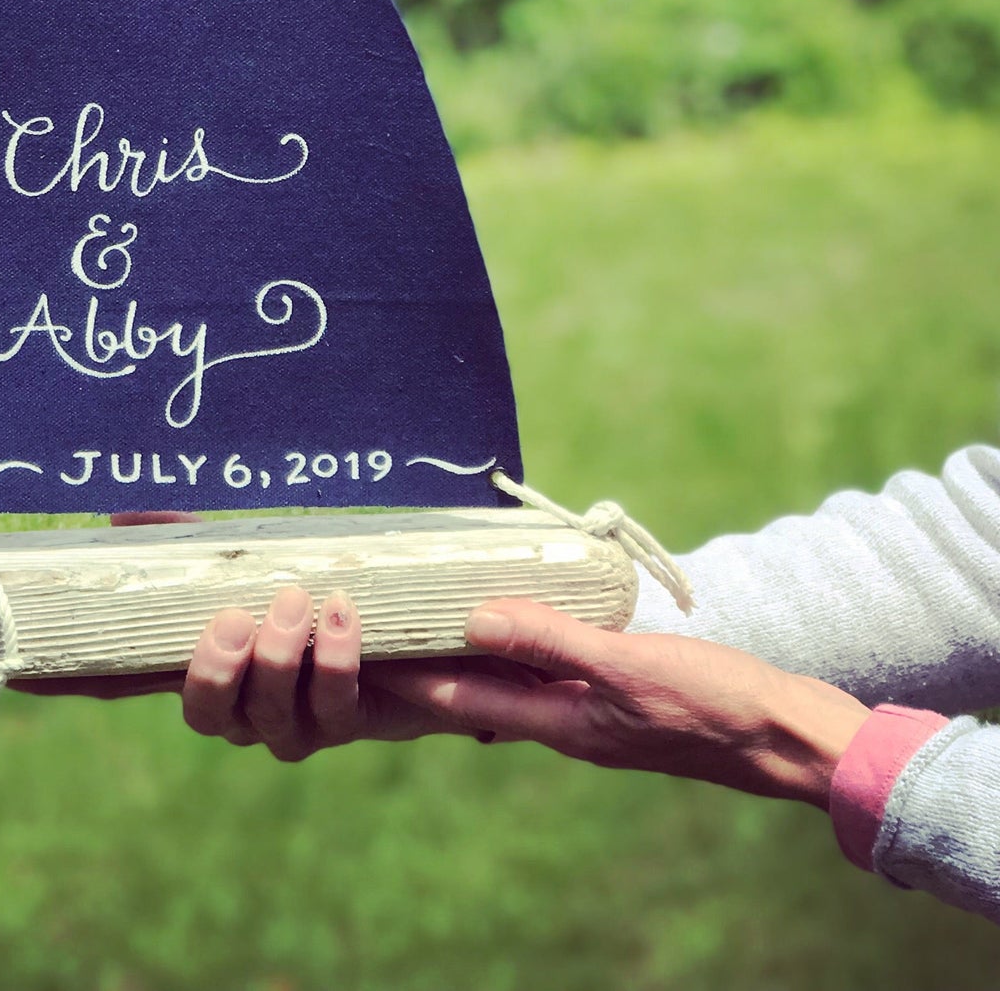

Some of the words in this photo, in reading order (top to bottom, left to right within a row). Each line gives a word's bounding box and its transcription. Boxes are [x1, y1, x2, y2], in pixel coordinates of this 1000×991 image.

[1, 102, 309, 198] Chris
[70, 213, 139, 290] &
[60, 450, 208, 487] JULY
[222, 453, 272, 490] 6,
[284, 449, 393, 490] 2019
